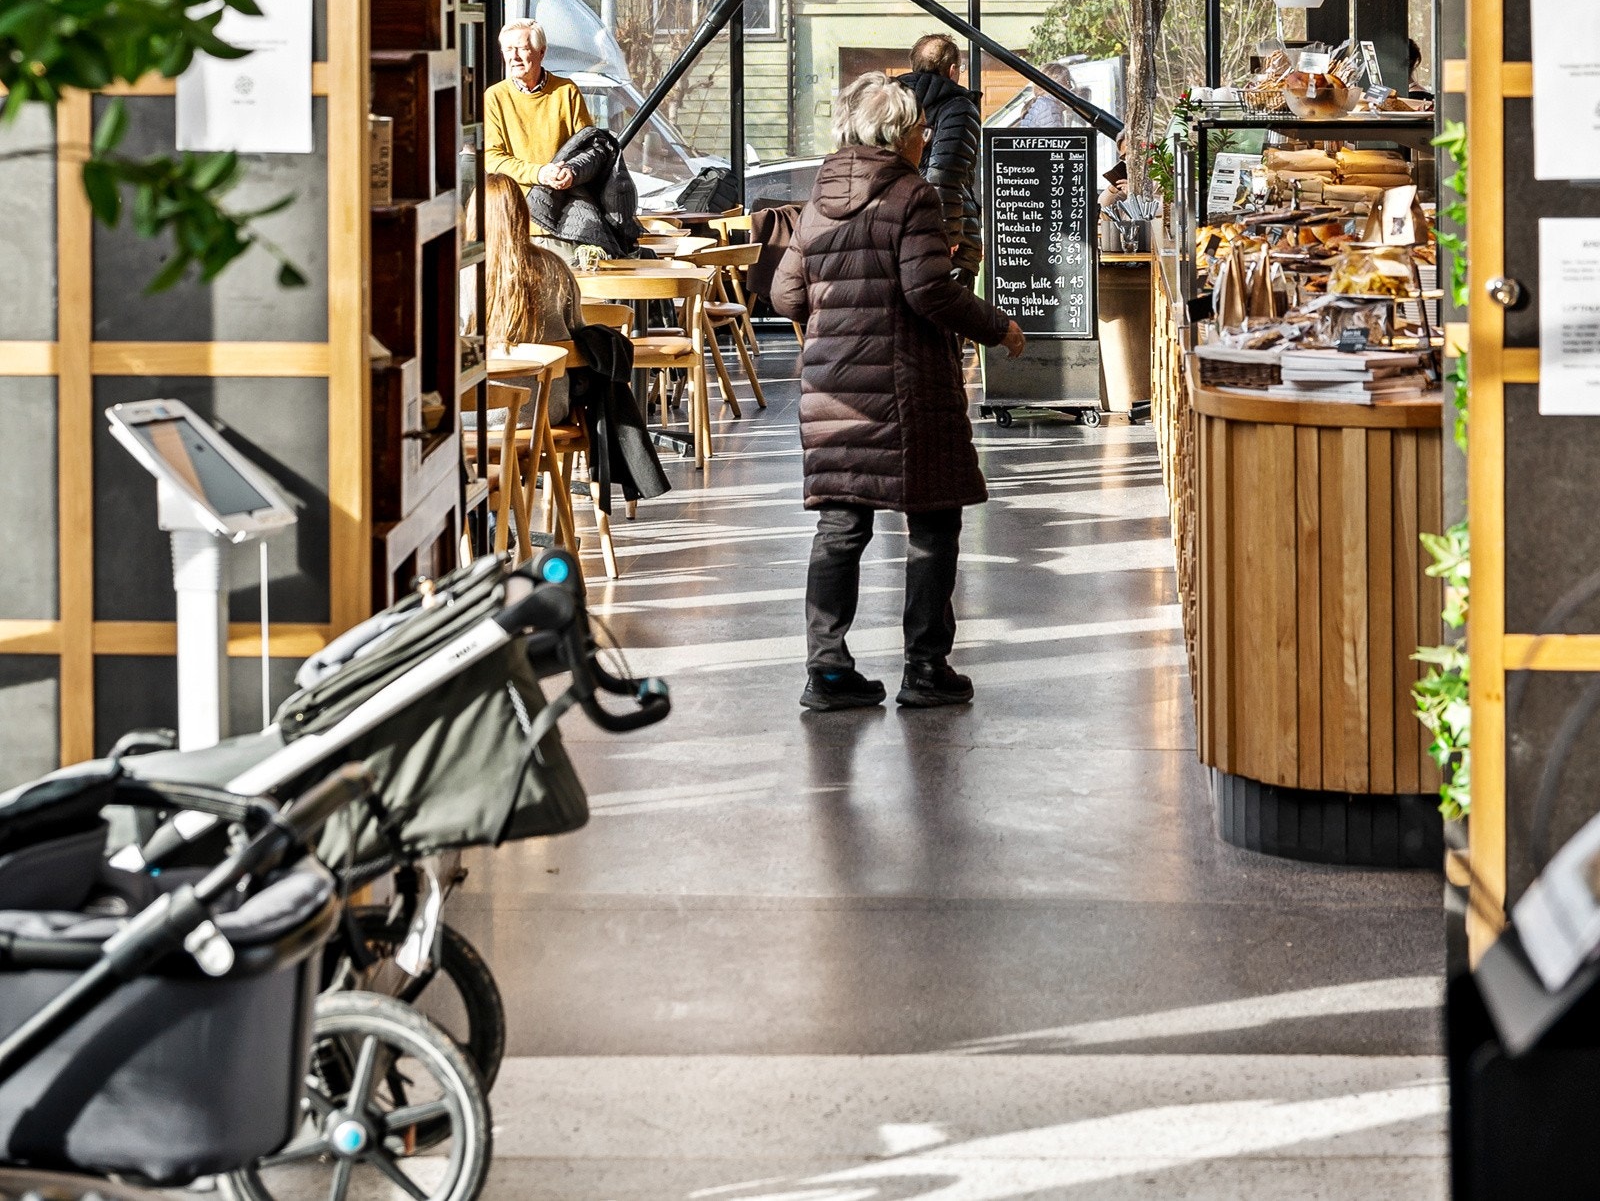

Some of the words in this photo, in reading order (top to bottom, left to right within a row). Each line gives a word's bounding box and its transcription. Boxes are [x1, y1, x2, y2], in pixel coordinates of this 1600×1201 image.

[1012, 139, 1072, 149] KAFFEMENY
[996, 162, 1035, 176] Espresso
[1051, 163, 1065, 173] 34
[1072, 163, 1084, 173] 38
[996, 175, 1040, 185] Americano
[1050, 175, 1064, 185] 37
[1071, 175, 1081, 185] 41
[995, 187, 1031, 196] Cortado
[1050, 187, 1064, 196] 50
[1070, 186, 1085, 197] 54
[995, 199, 1045, 212] Cappuccino
[1050, 199, 1061, 208] 51
[1071, 198, 1086, 208] 55
[996, 211, 1018, 220] Kaffe
[1022, 211, 1044, 220] latte
[1050, 210, 1063, 219] 58
[1070, 209, 1083, 219] 62
[997, 222, 1042, 232] Macchiato
[1049, 221, 1063, 232] 37
[1069, 221, 1080, 231] 41
[997, 233, 1028, 244] Mocca
[1049, 232, 1063, 242] 62
[1068, 232, 1081, 241] 66
[1048, 243, 1062, 253] 65
[1067, 243, 1080, 254] 69
[1048, 255, 1063, 265] 60
[1066, 255, 1082, 264] 64
[995, 277, 1027, 292] Dagens
[1031, 275, 1052, 289] kaffe
[1054, 276, 1065, 288] 41
[1070, 276, 1084, 288] 45
[997, 294, 1020, 305] Varm
[1021, 292, 1060, 306] sjokolade
[1069, 294, 1084, 305] 58
[1022, 306, 1045, 316] latte
[1069, 306, 1080, 317] 51
[1068, 317, 1081, 328] 41
